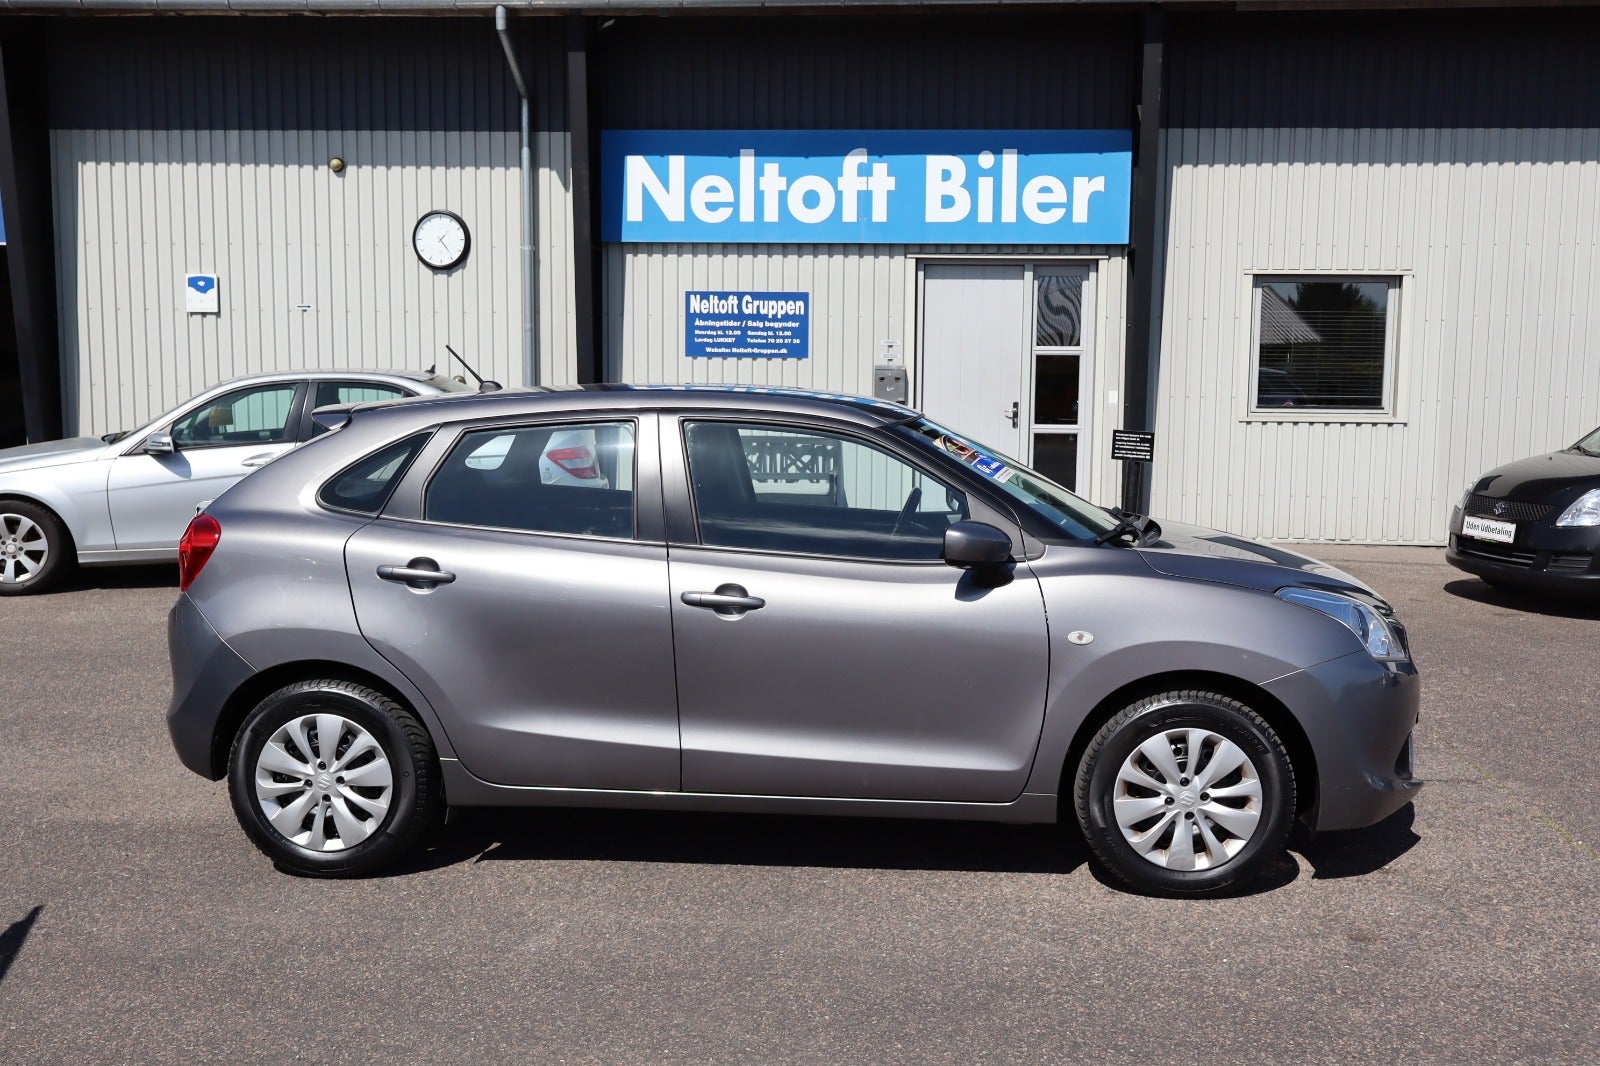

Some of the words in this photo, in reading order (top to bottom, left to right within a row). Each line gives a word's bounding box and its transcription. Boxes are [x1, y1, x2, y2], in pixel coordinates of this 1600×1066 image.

[626, 148, 896, 224] Neltoft
[925, 148, 1105, 225] Biler
[690, 294, 738, 314] Neltoft
[742, 294, 804, 318] Gruppen
[694, 318, 741, 328] Åbningstider
[747, 320, 764, 328] Salg
